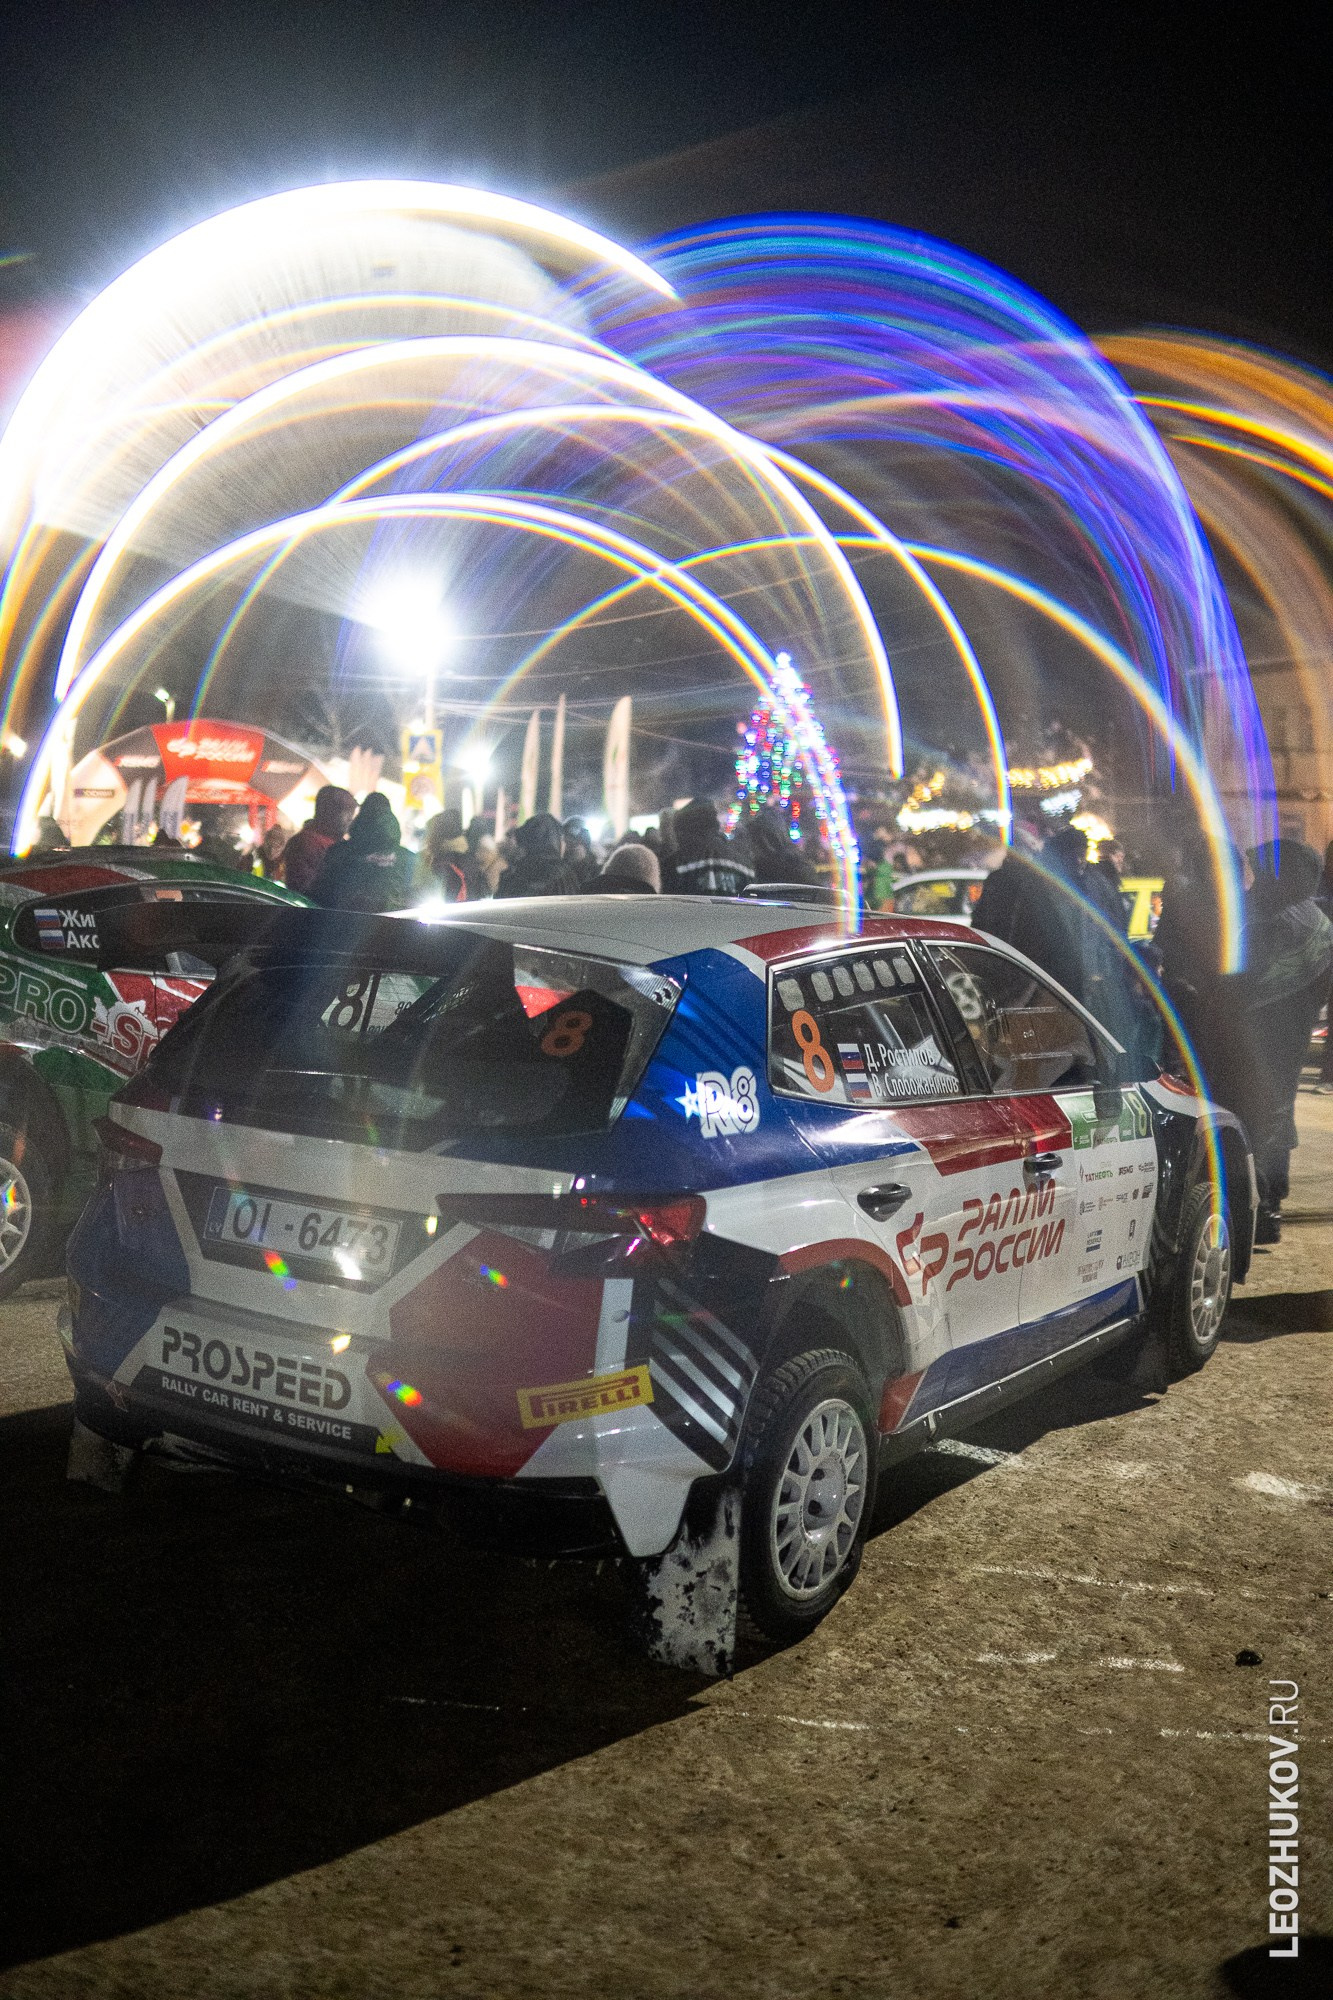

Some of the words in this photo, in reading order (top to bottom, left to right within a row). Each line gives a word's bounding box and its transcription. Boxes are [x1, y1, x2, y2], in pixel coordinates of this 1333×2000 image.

[541, 1010, 593, 1057] 8
[791, 1009, 836, 1093] 8
[864, 1043, 880, 1072] Д.
[871, 1073, 886, 1098] В.
[1127, 1092, 1147, 1137] 8
[957, 1178, 1056, 1242] РАЛЛИ
[945, 1218, 1066, 1292] РОССИИ
[161, 1325, 352, 1411] PROSPEED
[161, 1376, 198, 1398] RALLY
[202, 1389, 229, 1408] CAR
[232, 1398, 269, 1419] RENT
[273, 1408, 284, 1423] &
[287, 1412, 352, 1440] SERVICE
[528, 1375, 641, 1419] PIRELLI
